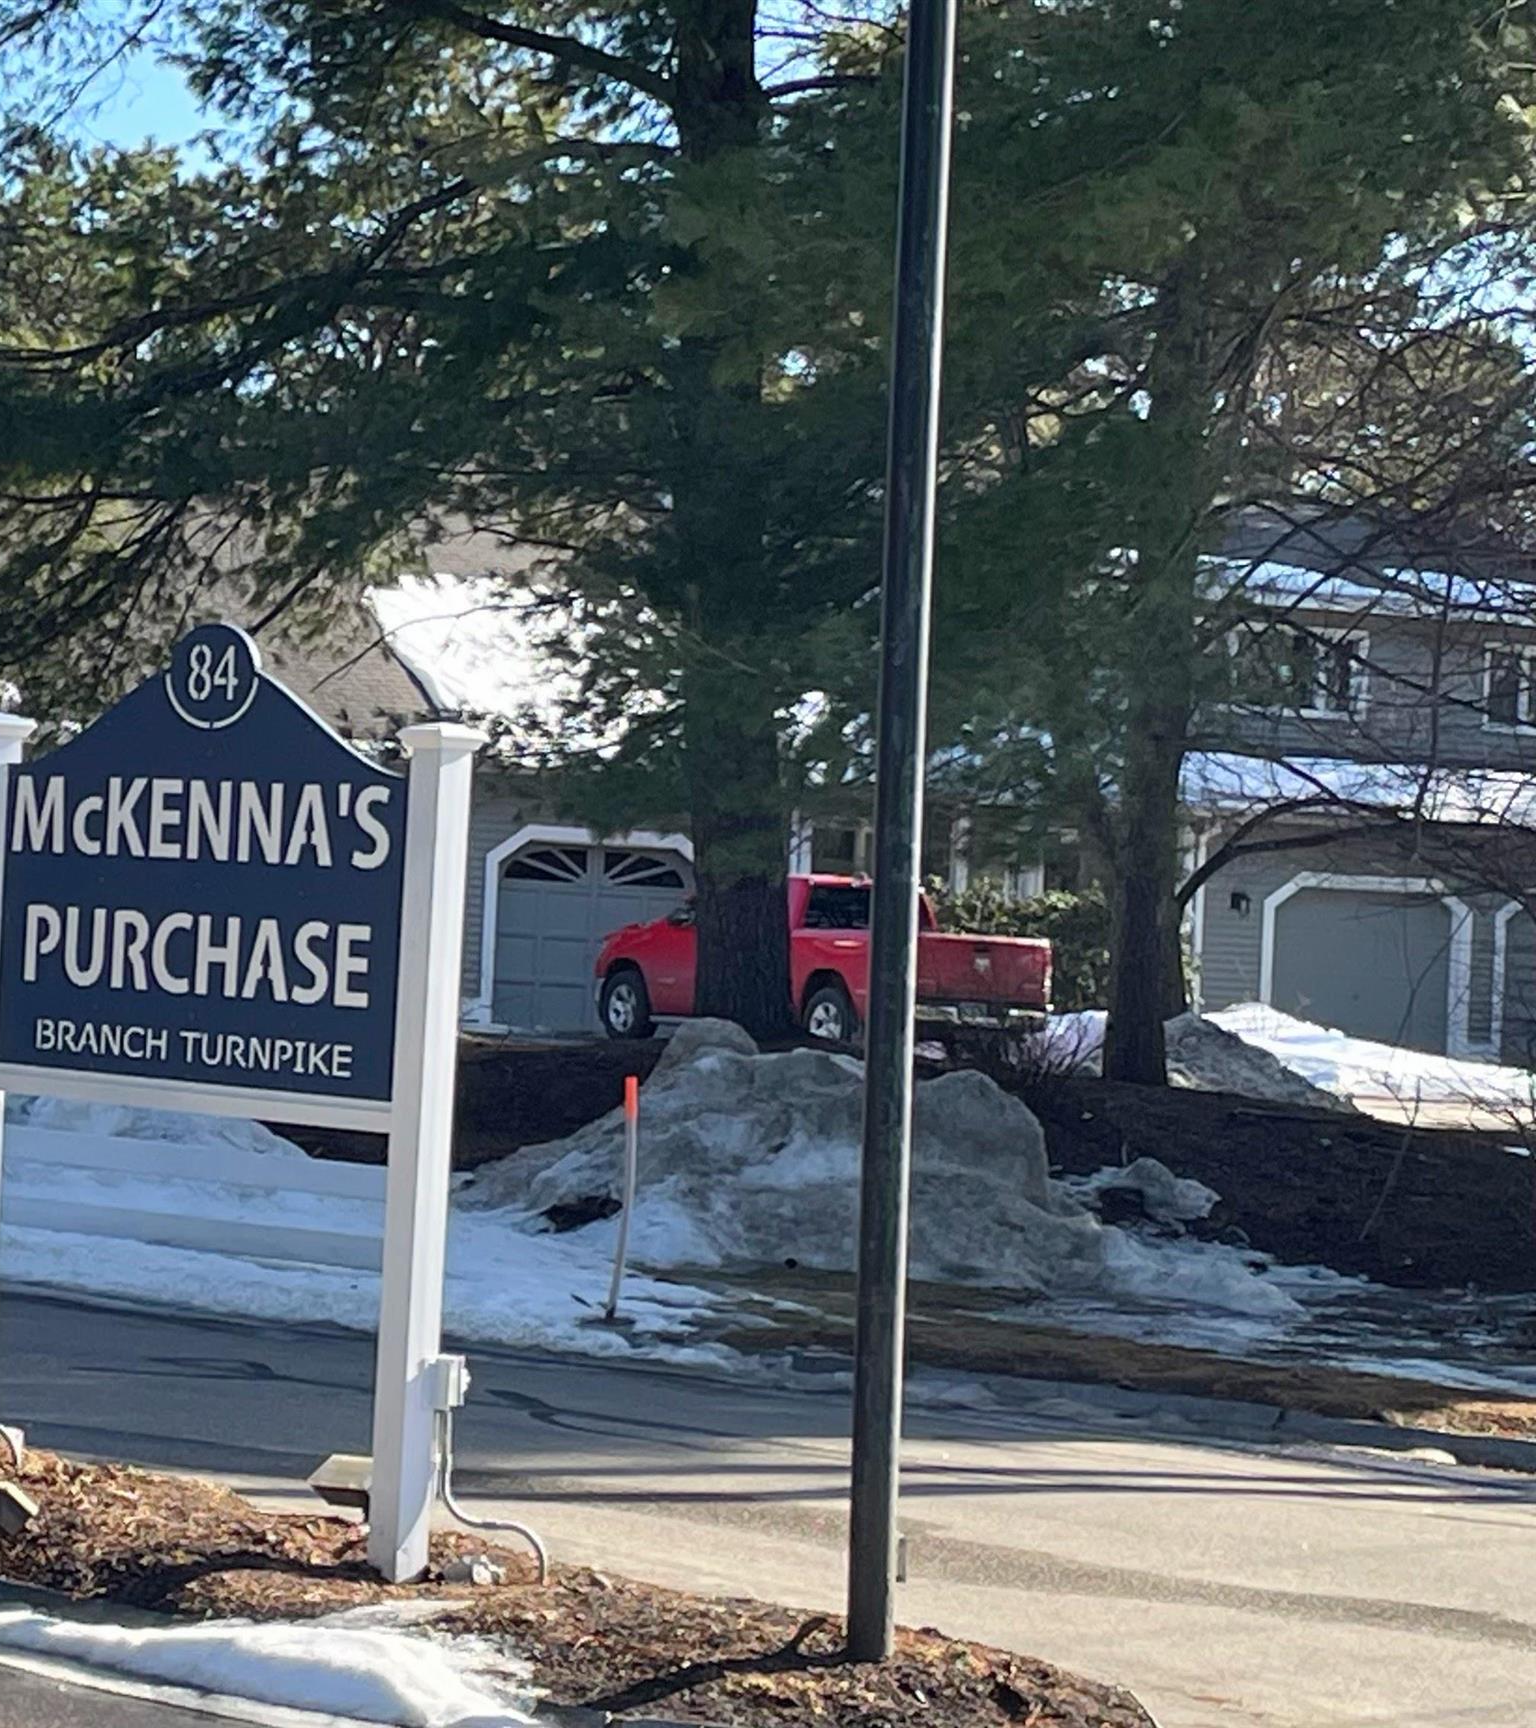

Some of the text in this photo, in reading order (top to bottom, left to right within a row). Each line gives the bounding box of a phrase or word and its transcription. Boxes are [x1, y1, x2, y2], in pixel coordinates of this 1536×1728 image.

[188, 644, 239, 701] 84
[11, 775, 391, 869] McKENNA'S
[23, 904, 372, 1008] PURCHASE
[36, 1019, 353, 1078] BRANCH TURNPIKE
